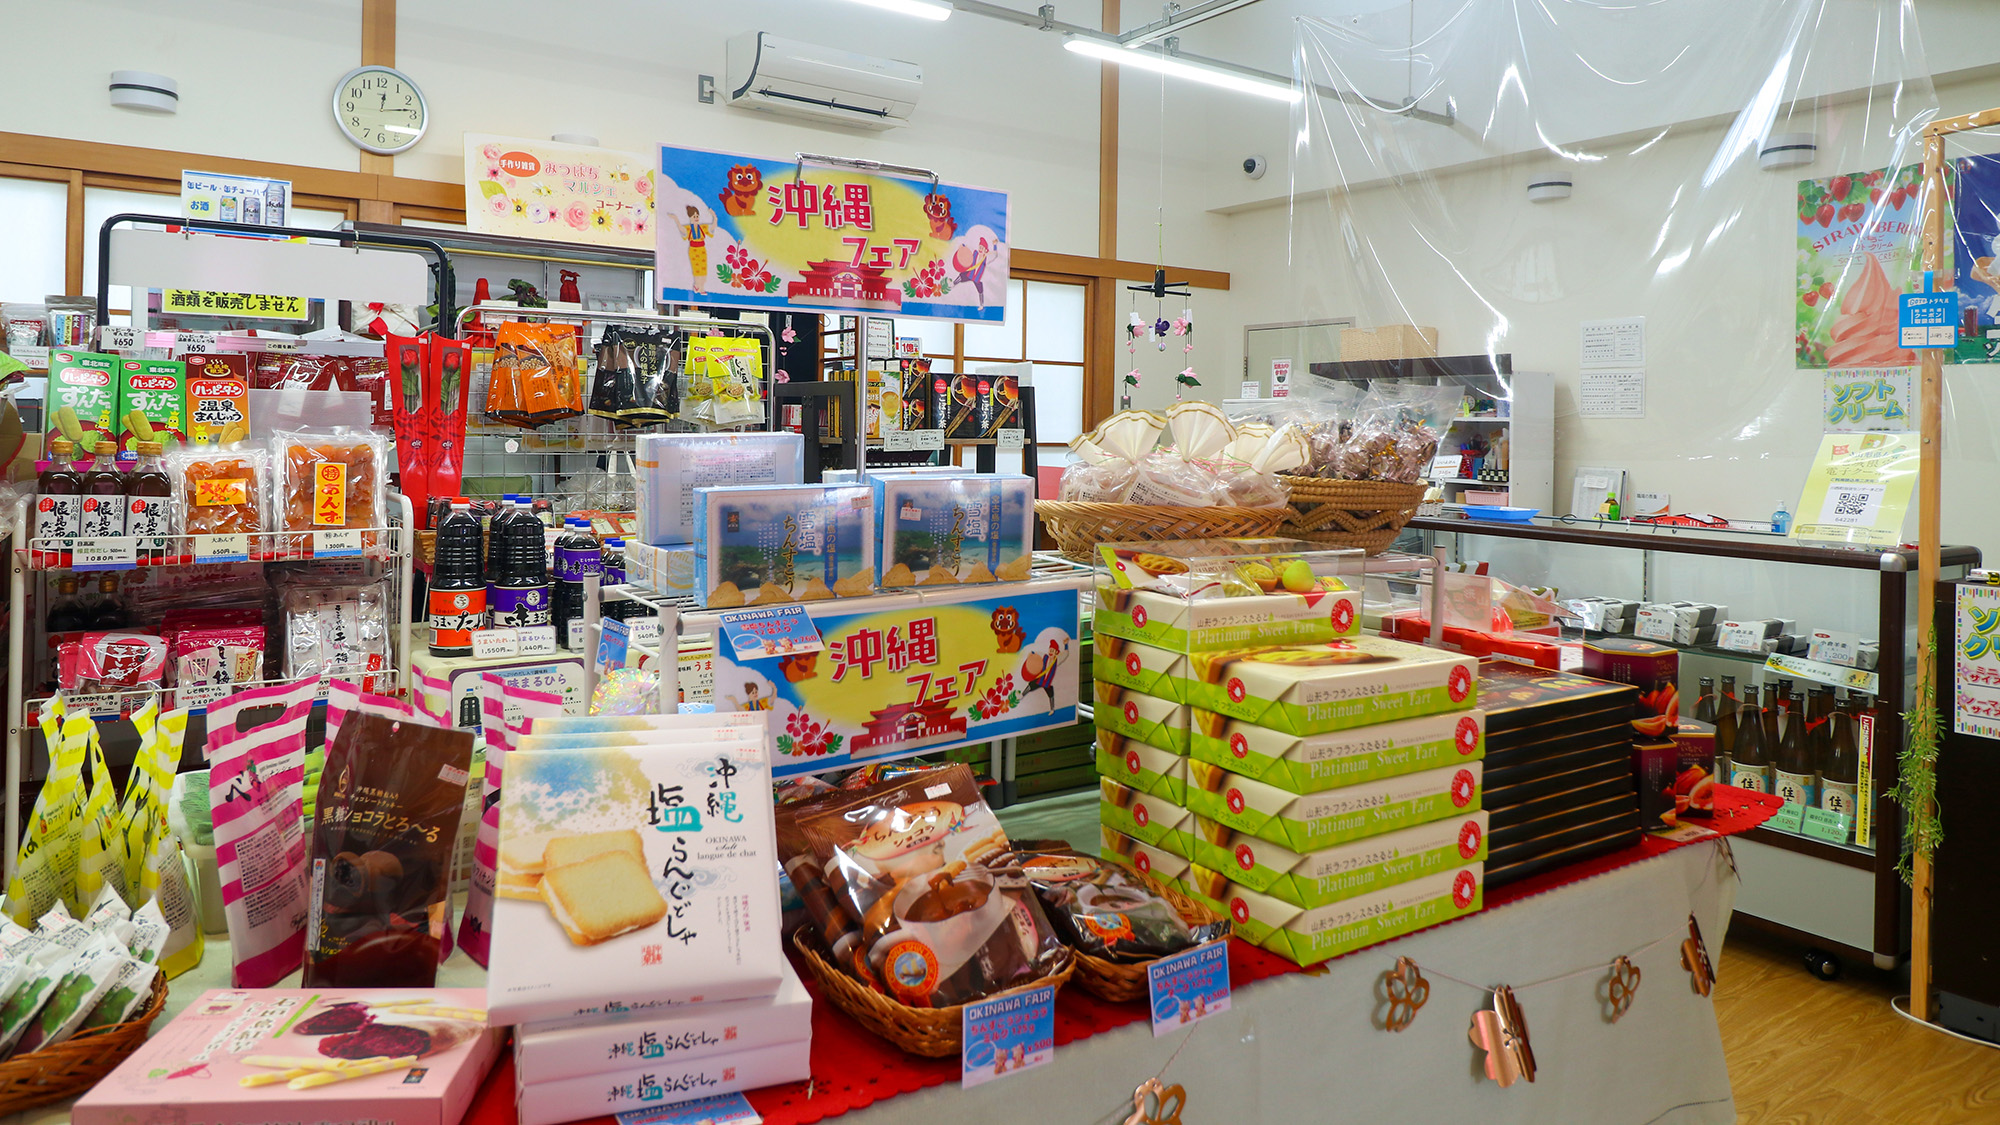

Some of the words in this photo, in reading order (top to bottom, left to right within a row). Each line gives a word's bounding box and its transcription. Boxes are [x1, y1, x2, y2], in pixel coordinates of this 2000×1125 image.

[362, 79, 371, 89] 11
[376, 78, 388, 88] 12
[396, 84, 400, 93] 1
[351, 88, 362, 98] 10
[405, 95, 412, 105] 2
[346, 102, 354, 112] 9
[352, 117, 360, 127] 8
[409, 110, 417, 120] 3
[364, 128, 370, 138] 7
[377, 133, 385, 143] 6
[500, 159, 536, 171] 手作り雑貨
[544, 162, 599, 180] みつばち
[564, 180, 618, 199] マルシェ
[190, 200, 210, 211] お酒
[596, 200, 633, 211] コーナー
[766, 180, 873, 231] 沖縄
[842, 236, 921, 269] フェア
[172, 293, 299, 312] 酒類を販売しません
[114, 338, 133, 347] ¥650
[187, 344, 206, 352] ¥650
[64, 371, 109, 386] ハッピーターン
[132, 377, 176, 390] ハッピーターン
[195, 383, 243, 396] ハッピーターン
[1833, 379, 1895, 404] ソフト
[200, 400, 236, 412] 温泉
[1827, 401, 1905, 425] クリーム
[194, 412, 244, 422] まんじゅう
[318, 484, 341, 523] あんず
[966, 502, 982, 536] 雪塩
[800, 510, 816, 550] 雪塩
[951, 504, 965, 577] ちんすこう
[781, 516, 798, 594] ちんすこう
[724, 610, 774, 623] OKINAWA
[777, 606, 803, 616] FAIR
[793, 634, 818, 643] ¥760
[1197, 627, 1250, 645] Platinum
[1258, 624, 1288, 638] Sweet
[1291, 622, 1315, 635] Tart
[828, 617, 938, 682] 沖縄
[507, 674, 566, 688] 味まるひら
[905, 659, 988, 707] フェア
[1307, 702, 1364, 722] Platinum
[1372, 695, 1404, 712] Sweet
[1408, 690, 1431, 706] Tart
[1310, 758, 1370, 779] Platinum
[1376, 750, 1409, 768] Sweet
[1415, 745, 1438, 760] Tart
[706, 757, 744, 823] 沖縄
[1307, 816, 1365, 837] Platinum
[1372, 805, 1405, 824] Sweet
[1410, 798, 1434, 814] Tart
[706, 835, 747, 844] OKINAWA
[697, 852, 724, 861] langue
[727, 851, 737, 859] de
[739, 850, 757, 858] chat
[1318, 871, 1375, 894] Platinum
[1382, 860, 1415, 879] Sweet
[1419, 851, 1442, 868] Tart
[1312, 926, 1369, 950] Platinum
[1376, 910, 1409, 930] Sweet
[1413, 902, 1437, 919] Tart
[1153, 956, 1198, 979] OKINAWA
[1200, 947, 1223, 963] FAIR
[1156, 962, 1222, 992] ちんすこうショコラ
[1192, 976, 1212, 990] 125g
[1207, 988, 1228, 1002] ¥500
[969, 997, 1021, 1020] OKINAWA
[1024, 991, 1050, 1007] FAIR
[971, 1007, 1047, 1035] ちんすこうショコラ
[1012, 1022, 1034, 1036] 125g
[1028, 1038, 1051, 1052] ¥500
